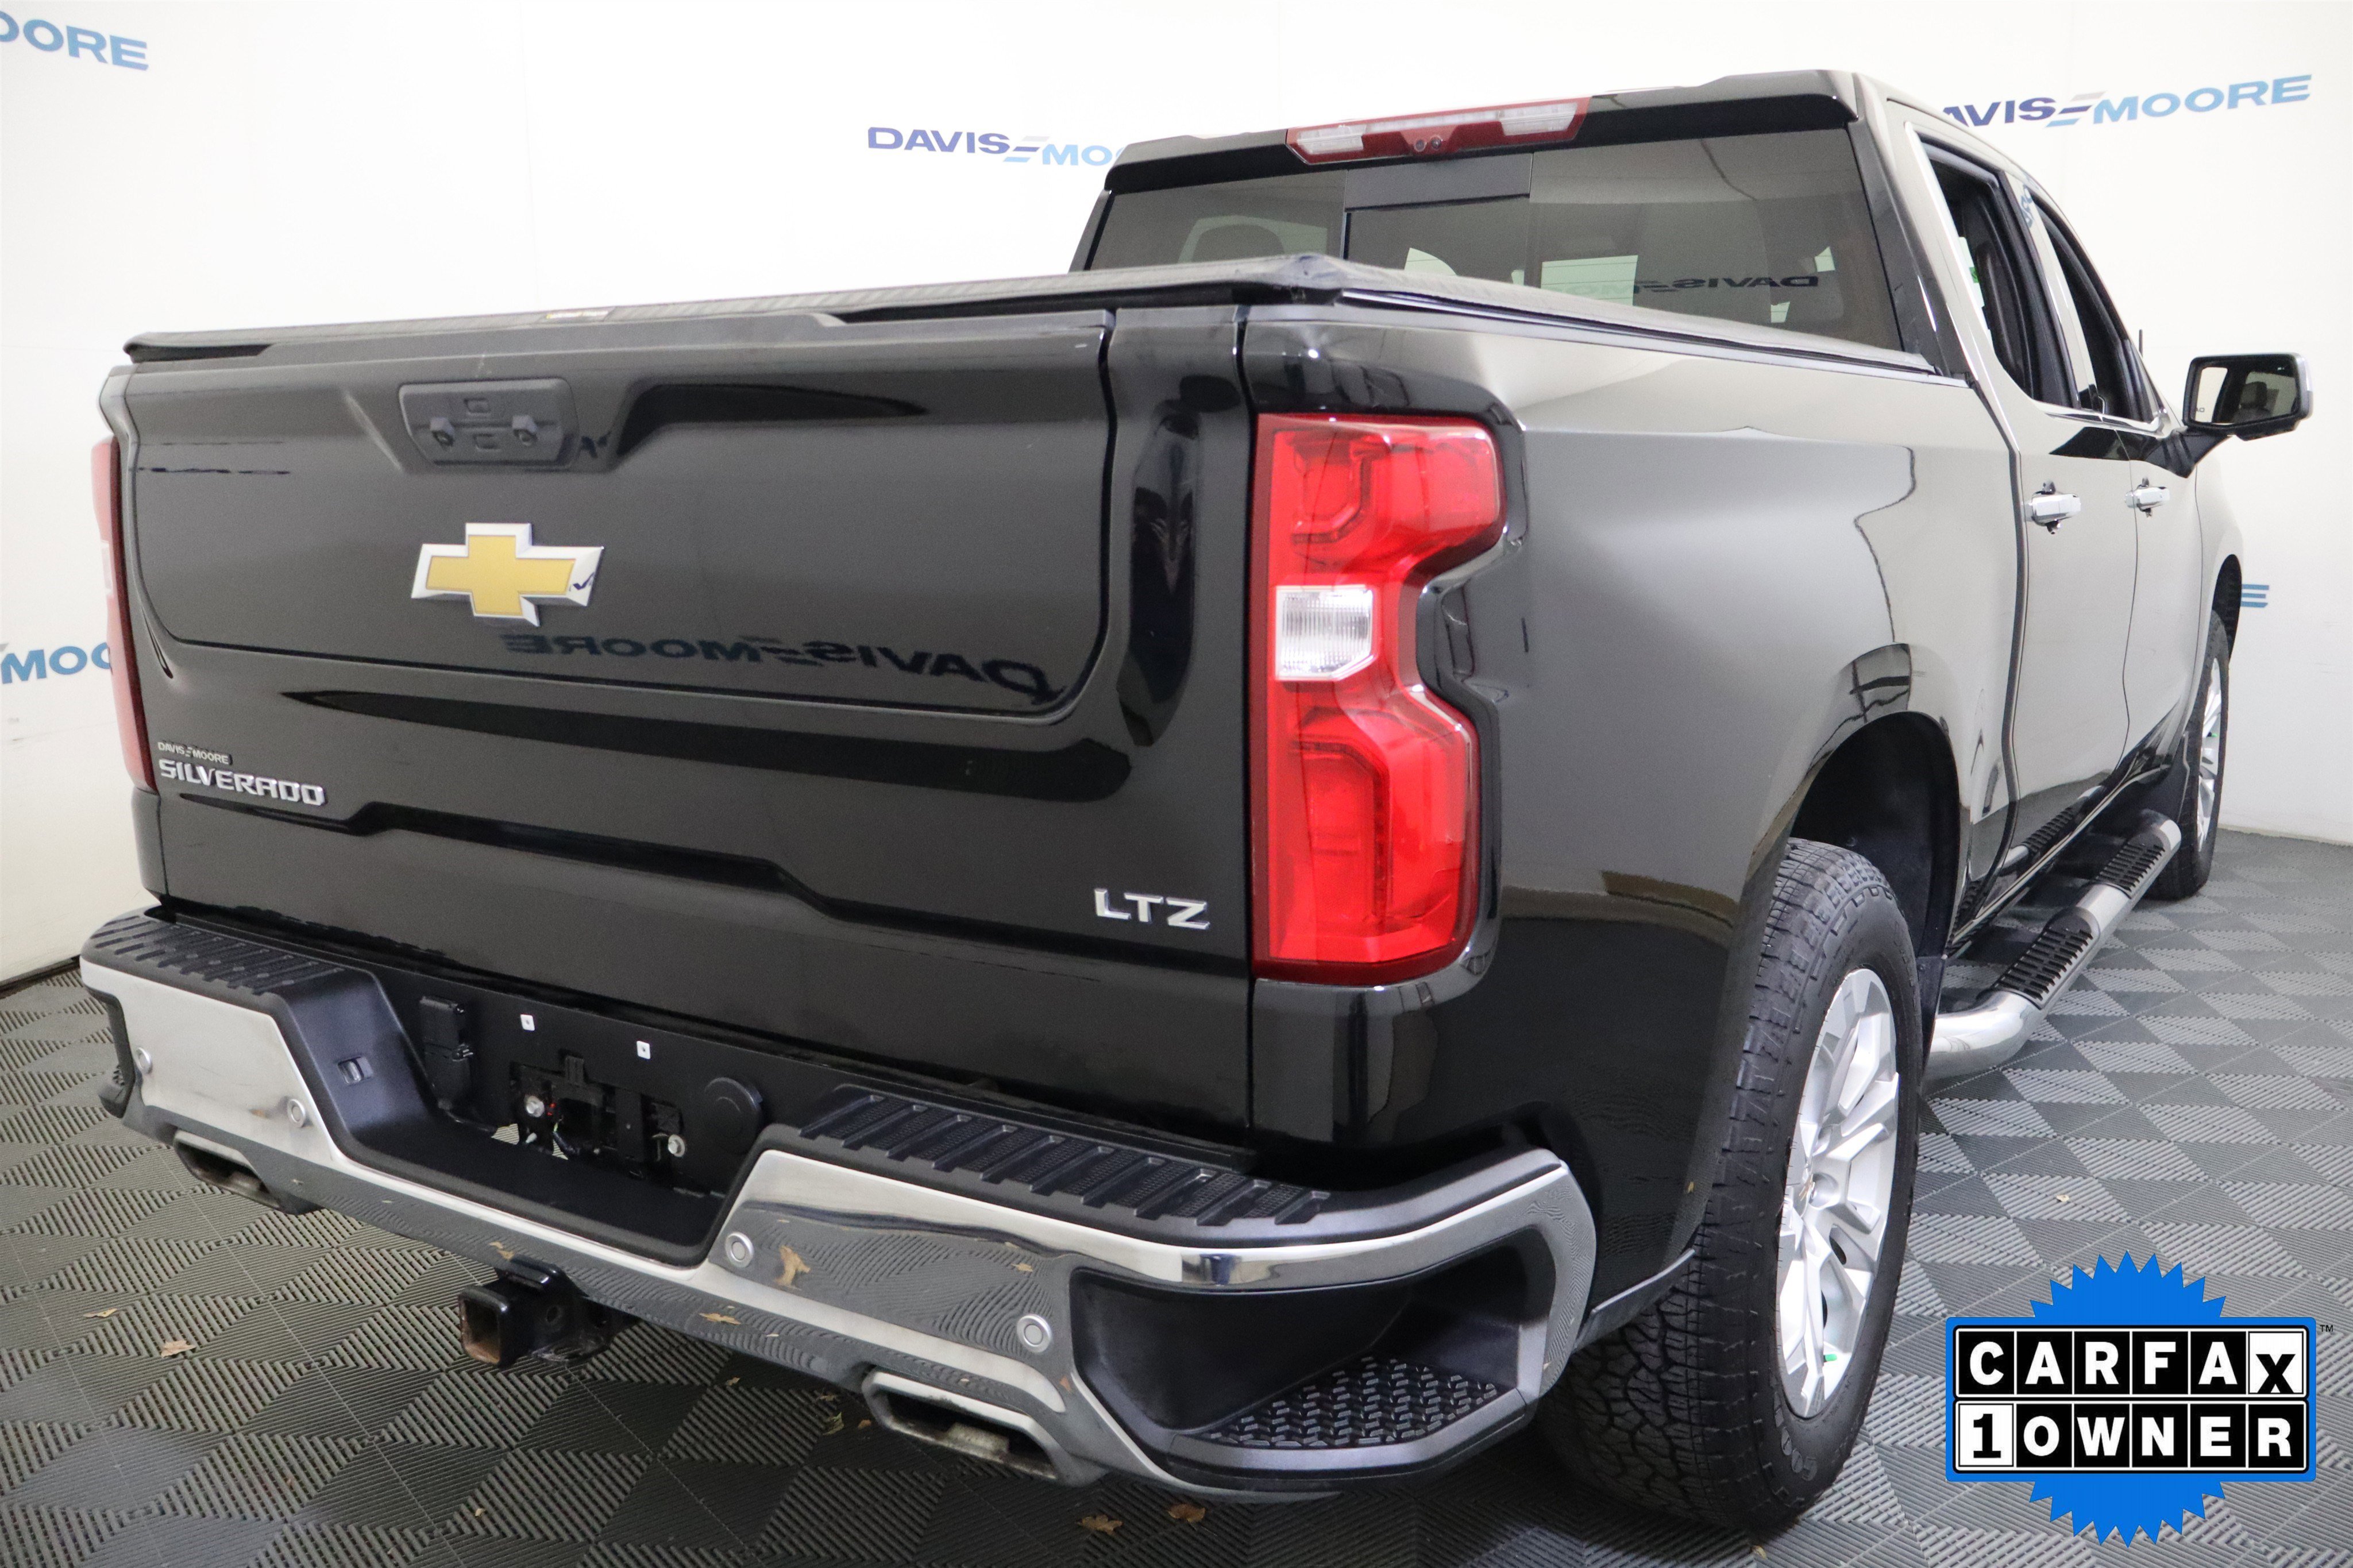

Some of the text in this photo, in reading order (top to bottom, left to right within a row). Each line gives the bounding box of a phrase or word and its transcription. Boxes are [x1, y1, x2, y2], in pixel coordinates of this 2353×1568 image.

[2093, 74, 2312, 124] MOORE
[867, 126, 1124, 167] DAVIS MO
[159, 758, 326, 806] SILVERADO
[1094, 889, 1210, 930] LTZ
